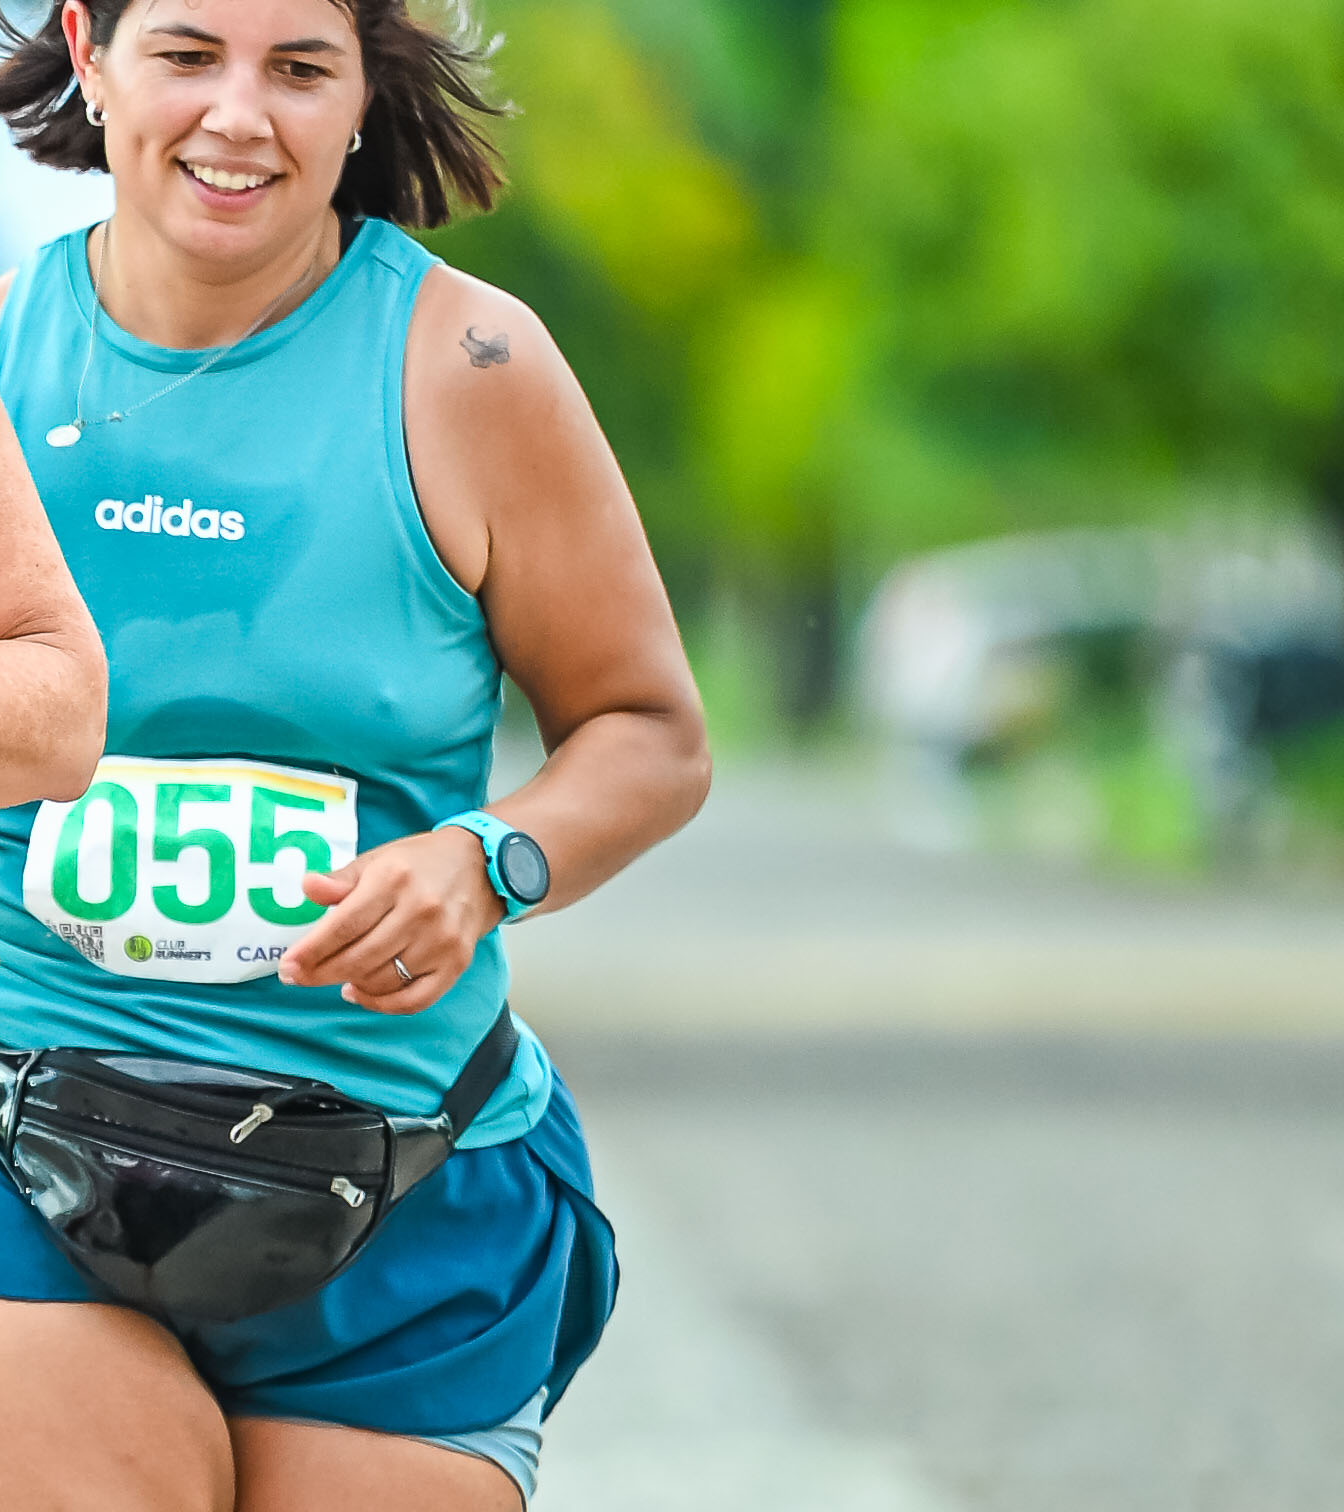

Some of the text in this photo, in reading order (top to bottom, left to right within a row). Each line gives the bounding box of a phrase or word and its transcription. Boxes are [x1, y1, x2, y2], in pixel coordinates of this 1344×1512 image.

[95, 495, 246, 541] adidas
[51, 782, 332, 926] 055
[236, 946, 288, 963] CAR
